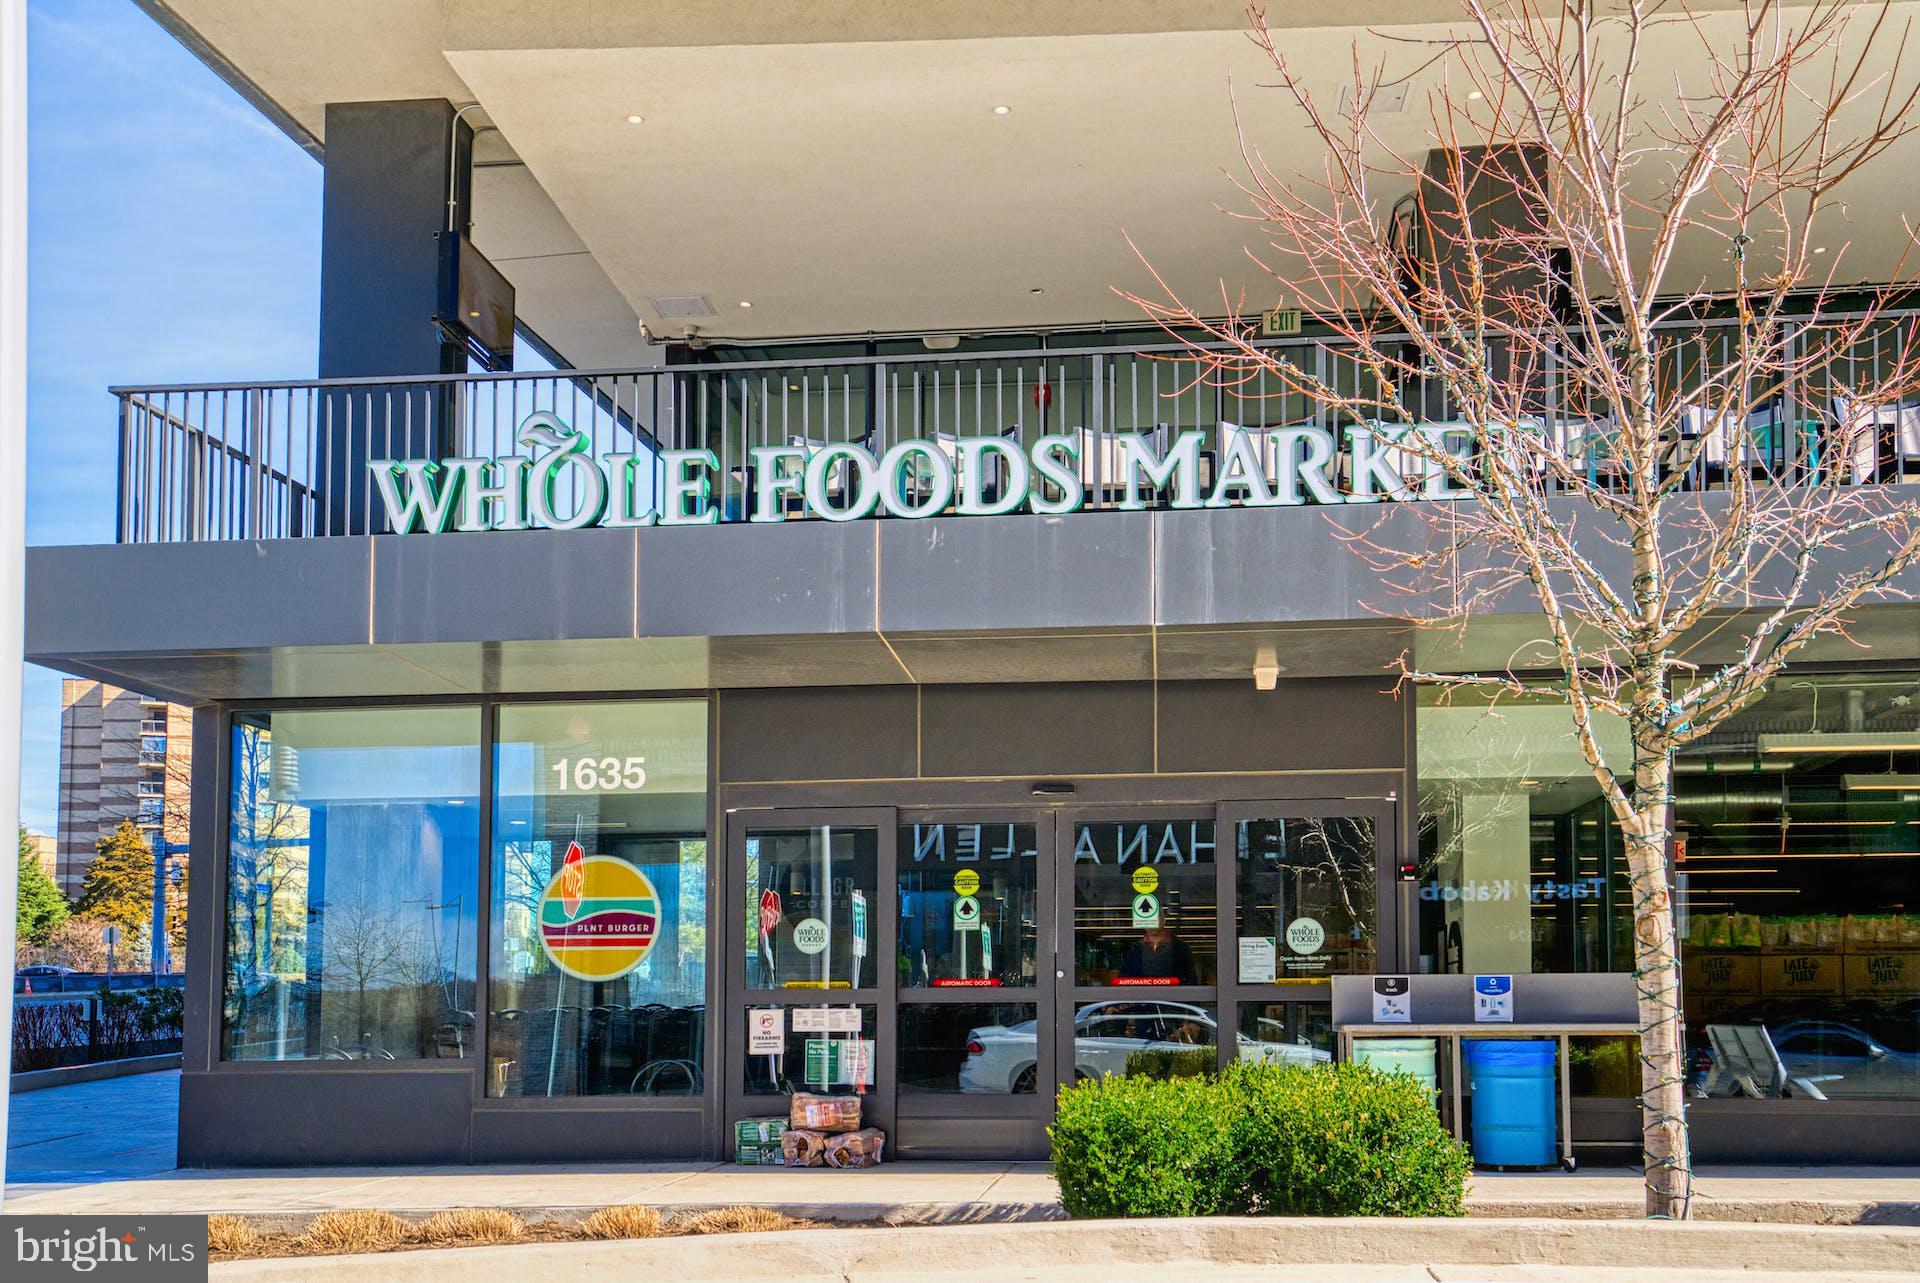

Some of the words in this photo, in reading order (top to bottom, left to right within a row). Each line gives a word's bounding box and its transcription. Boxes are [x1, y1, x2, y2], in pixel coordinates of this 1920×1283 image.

[1270, 312, 1296, 331] EXIT
[367, 410, 721, 535] WHOLE
[750, 433, 1084, 522] FOODS
[1118, 415, 1546, 510] MARKET
[552, 756, 647, 791] 1635
[1132, 876, 1158, 884] CAUTION
[577, 924, 603, 933] PLNT
[607, 923, 650, 933] BURGER
[797, 925, 826, 936] WHOLE
[1290, 925, 1321, 936] WHOLE
[799, 935, 825, 943] FOODS
[1292, 935, 1320, 943] FOODS
[1701, 957, 1726, 974] LATE
[1784, 957, 1809, 974] LATE
[1867, 956, 1893, 974] LATE
[1704, 967, 1732, 985] JULY
[1787, 967, 1816, 985] JULY
[1871, 967, 1900, 985] JULY
